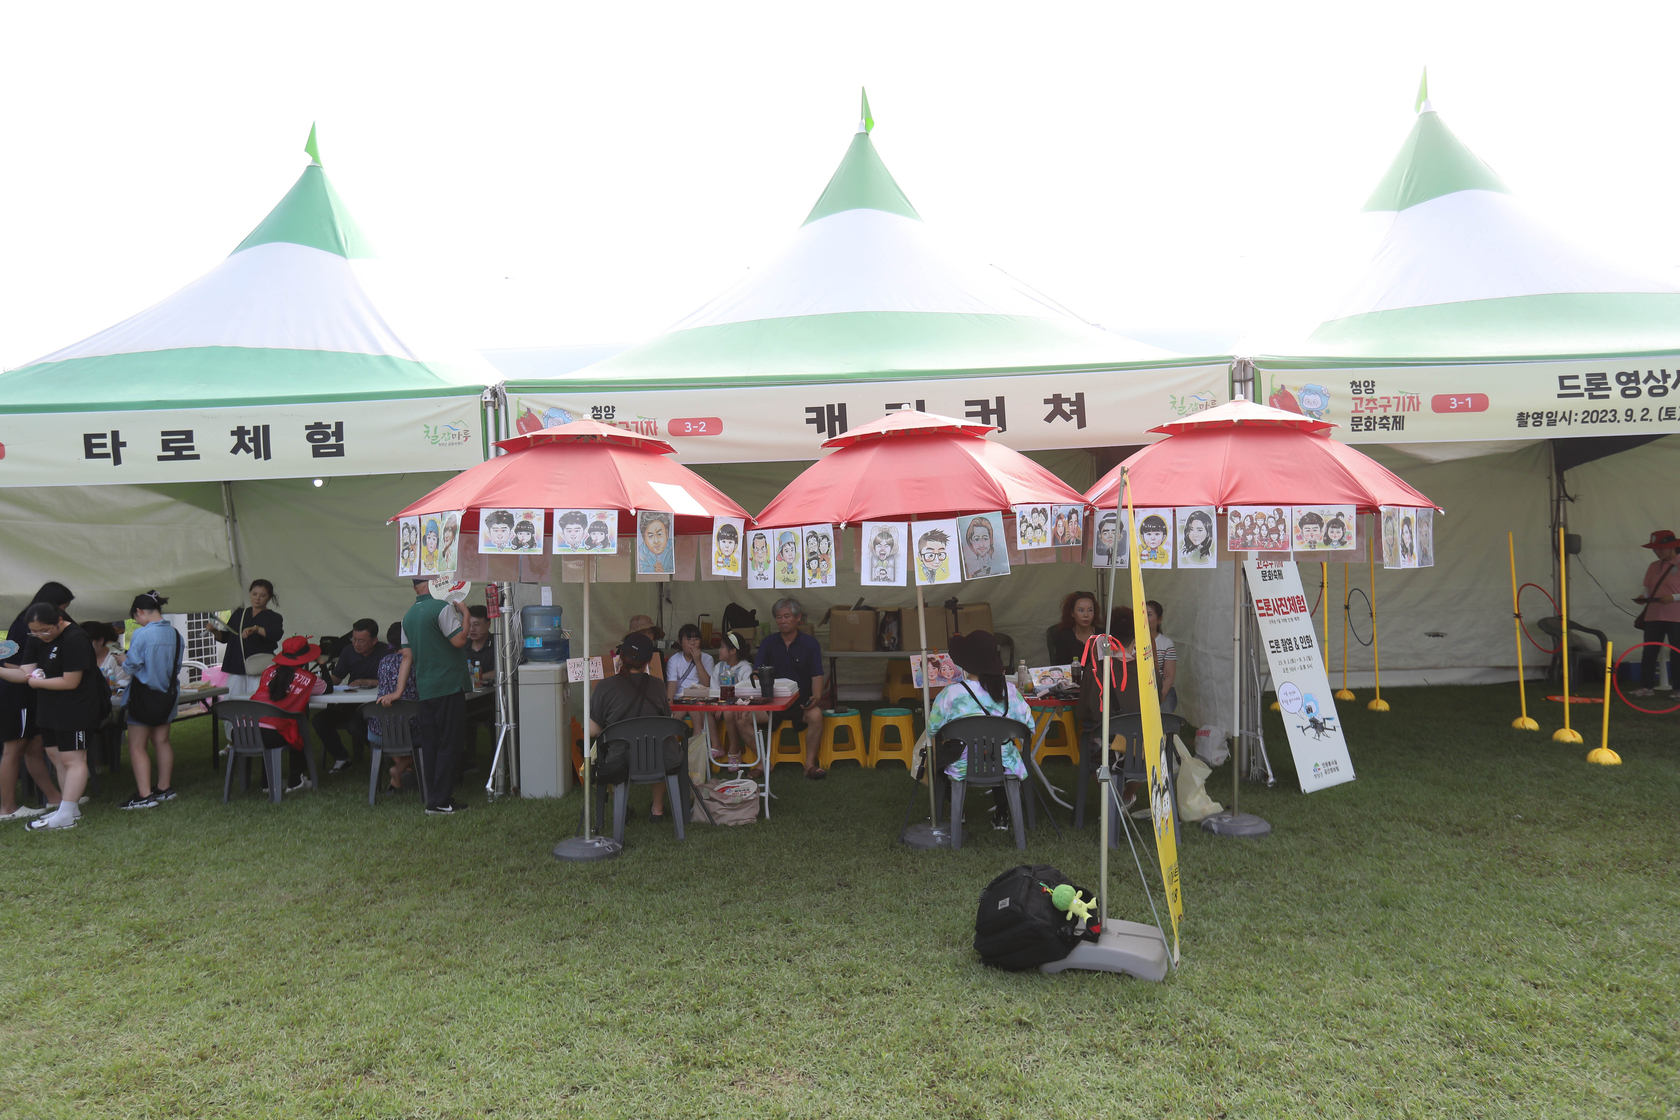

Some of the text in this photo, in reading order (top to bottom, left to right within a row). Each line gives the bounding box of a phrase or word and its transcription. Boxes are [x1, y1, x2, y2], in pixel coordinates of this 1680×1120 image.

[1350, 380, 1376, 395] 청양
[1351, 395, 1421, 414] 고추구기자
[1449, 397, 1472, 409] 3-1
[591, 405, 616, 420] 청양
[1515, 409, 1578, 428] 촬영일시:
[1580, 409, 1620, 424] 2023.
[1624, 408, 1637, 422] 9.
[1640, 407, 1653, 422] 2.
[600, 420, 659, 436] 구기자
[684, 421, 707, 433] 3-2
[1350, 415, 1405, 432] 문화축제
[423, 423, 471, 445] 칠갑마루
[1255, 594, 1307, 617] 드론사진체험
